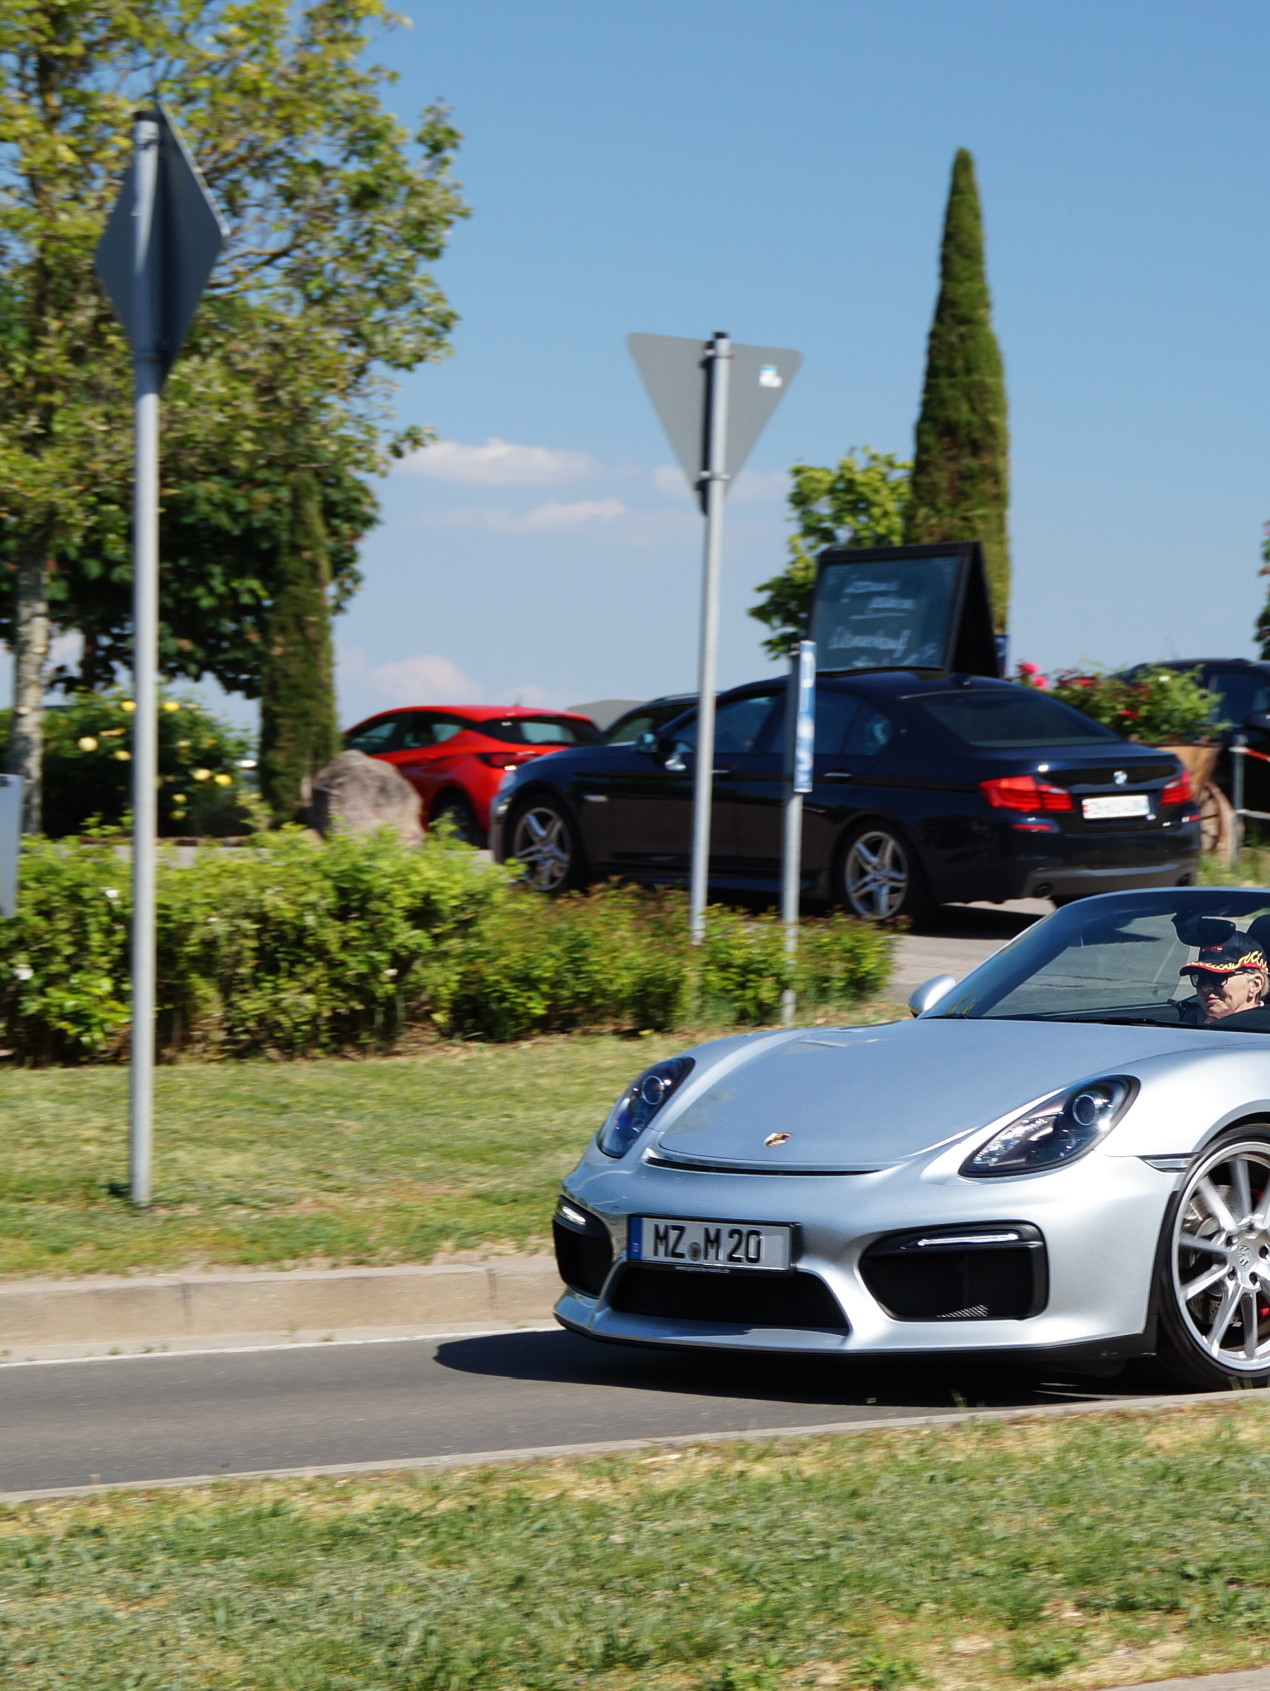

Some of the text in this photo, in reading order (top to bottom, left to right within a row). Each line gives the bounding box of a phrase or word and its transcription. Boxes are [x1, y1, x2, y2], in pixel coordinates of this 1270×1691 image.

[653, 1224, 762, 1263] MZ M 20
